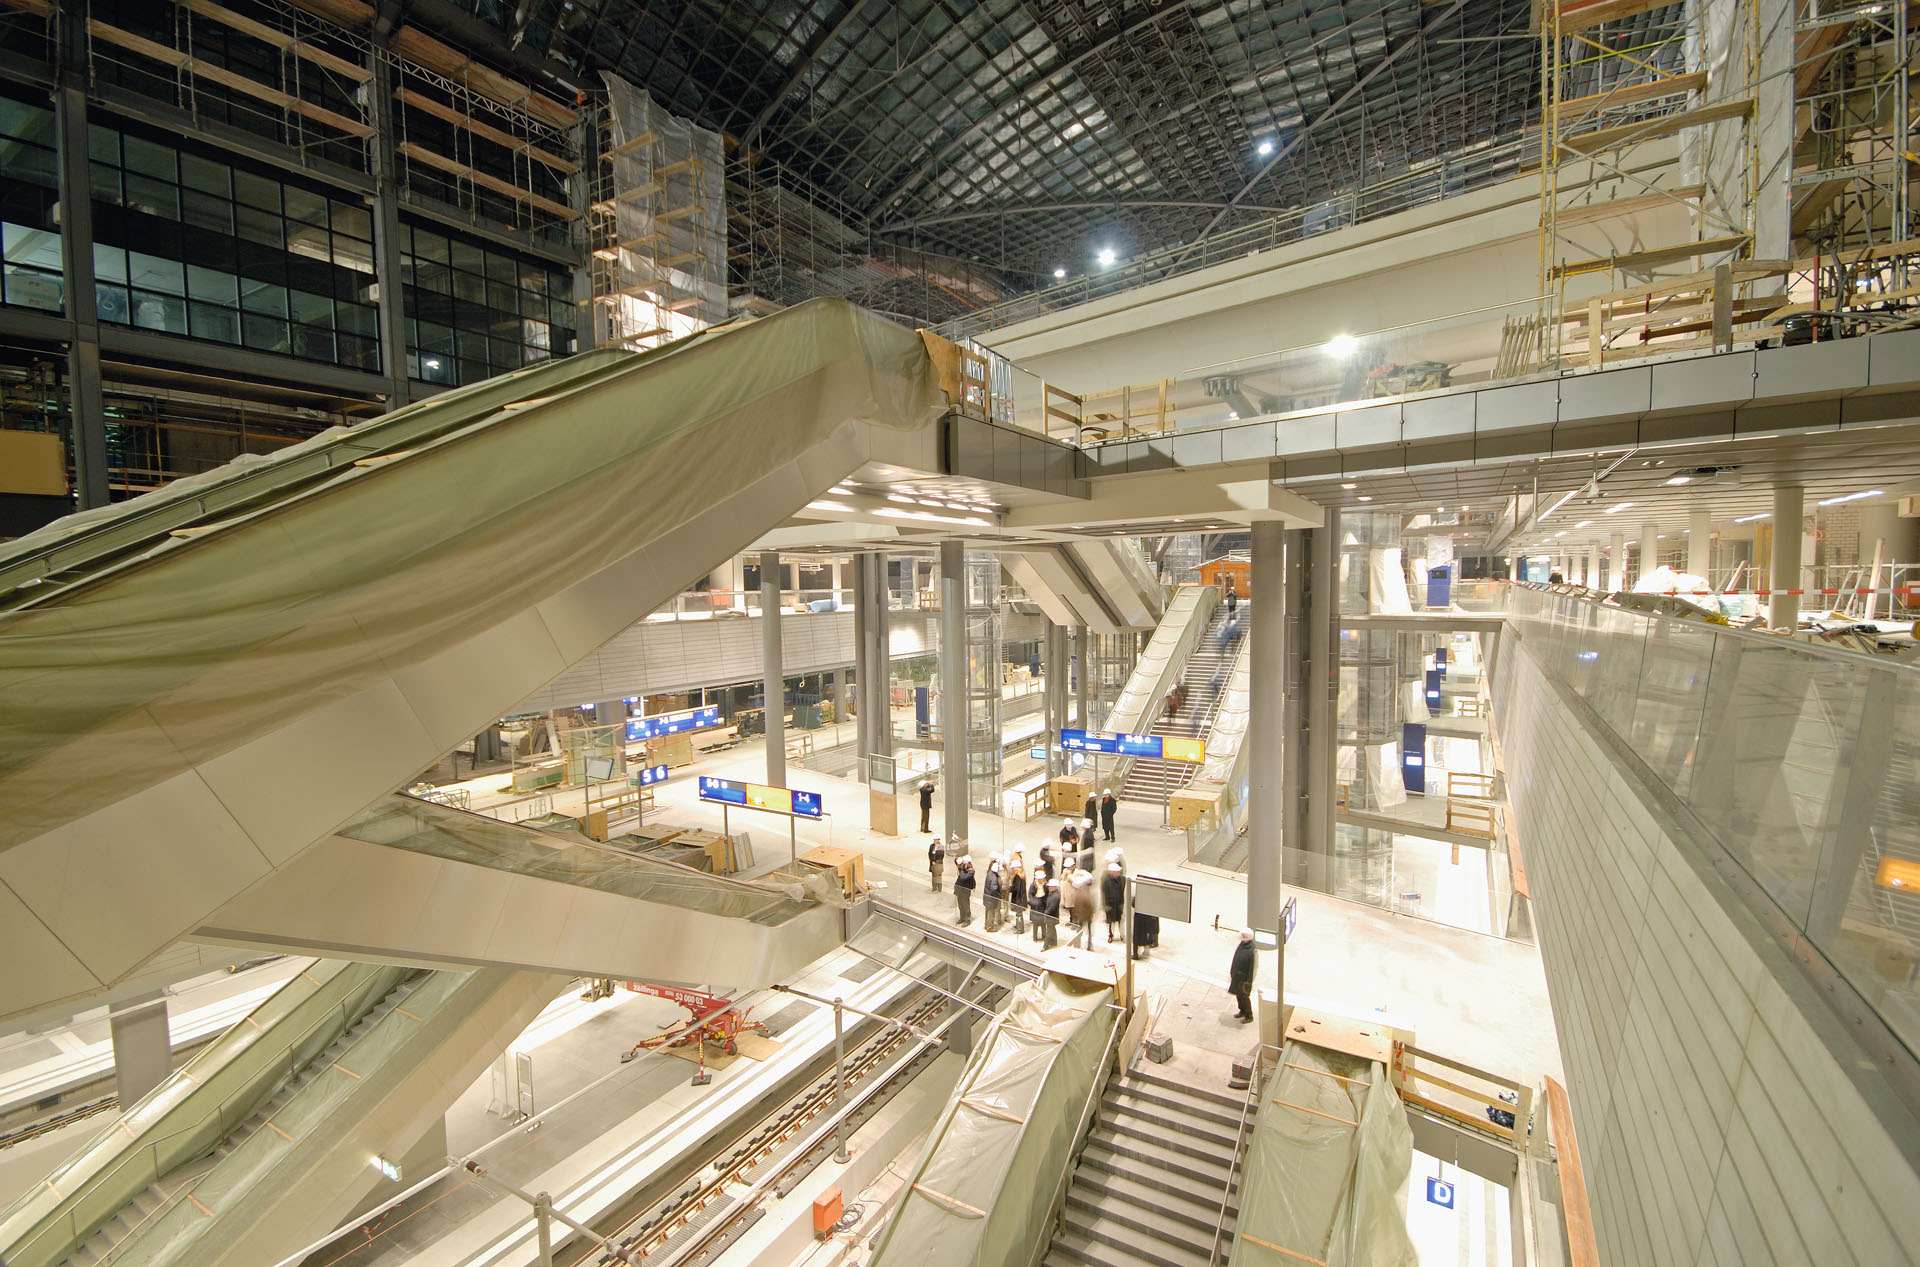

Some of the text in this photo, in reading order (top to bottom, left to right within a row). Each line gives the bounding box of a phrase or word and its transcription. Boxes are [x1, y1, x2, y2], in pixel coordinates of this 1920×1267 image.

[643, 765, 665, 783] 5 6
[1434, 1182, 1451, 1203] D
